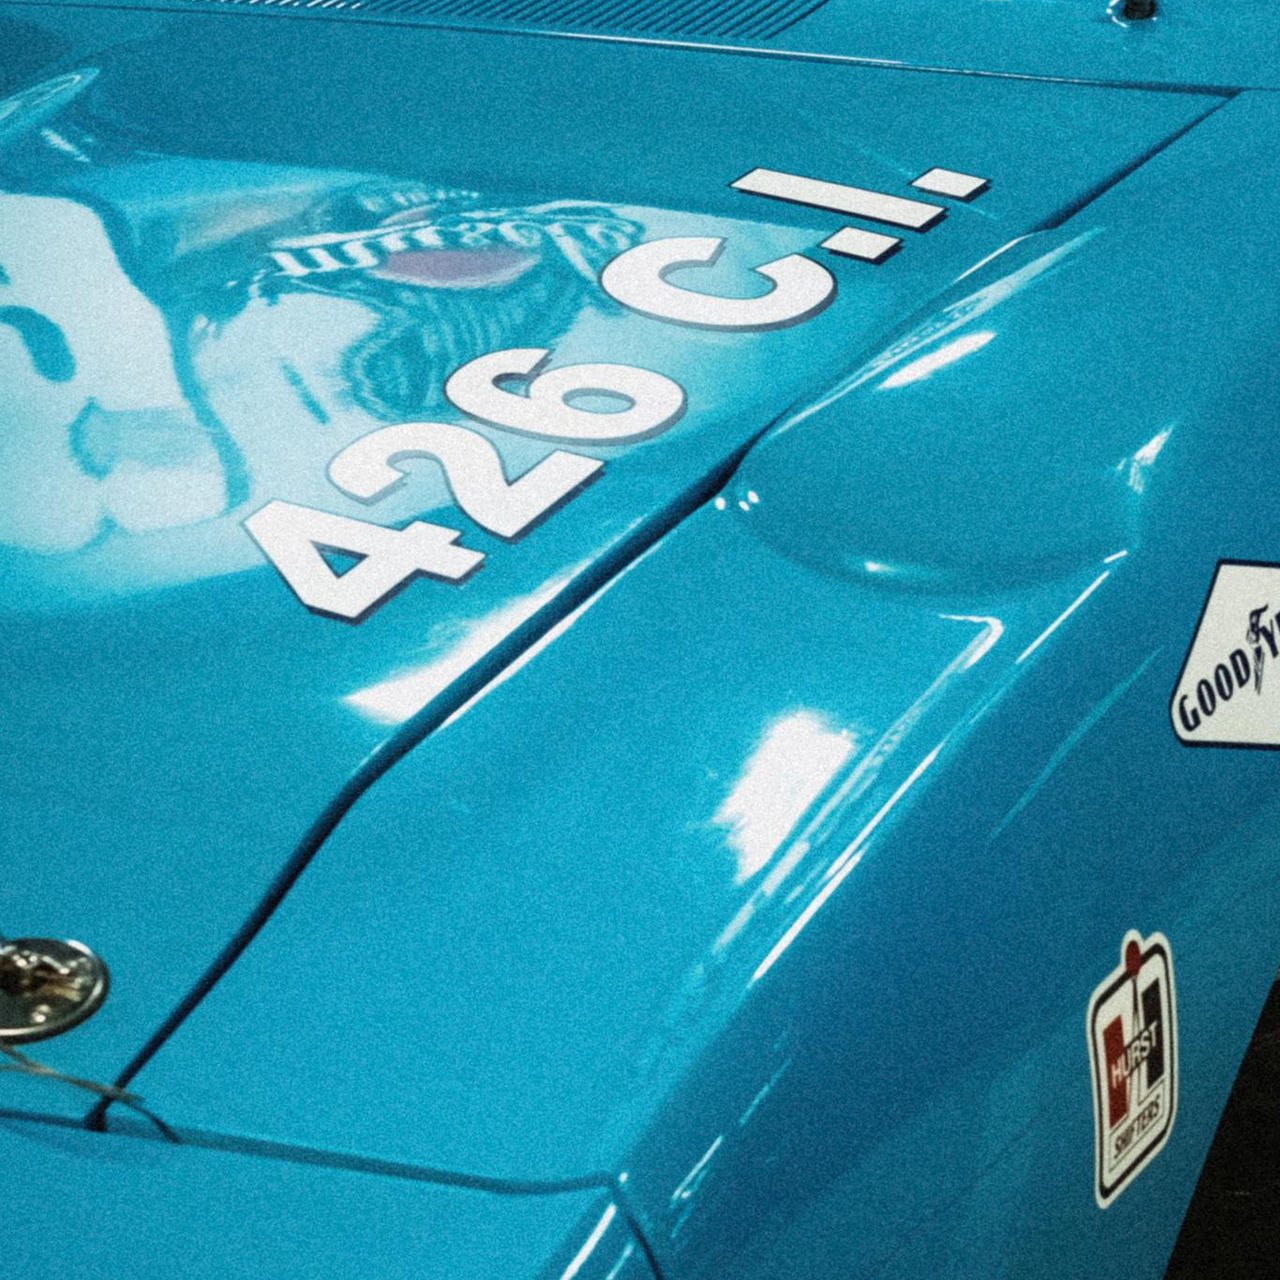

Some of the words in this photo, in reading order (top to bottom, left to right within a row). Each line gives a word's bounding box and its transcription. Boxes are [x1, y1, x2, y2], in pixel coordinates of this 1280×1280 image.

[242, 347, 688, 623] 426
[599, 166, 993, 331] C.I.
[1111, 1020, 1158, 1089] HURST
[1113, 1094, 1161, 1159] SHIFTERS
